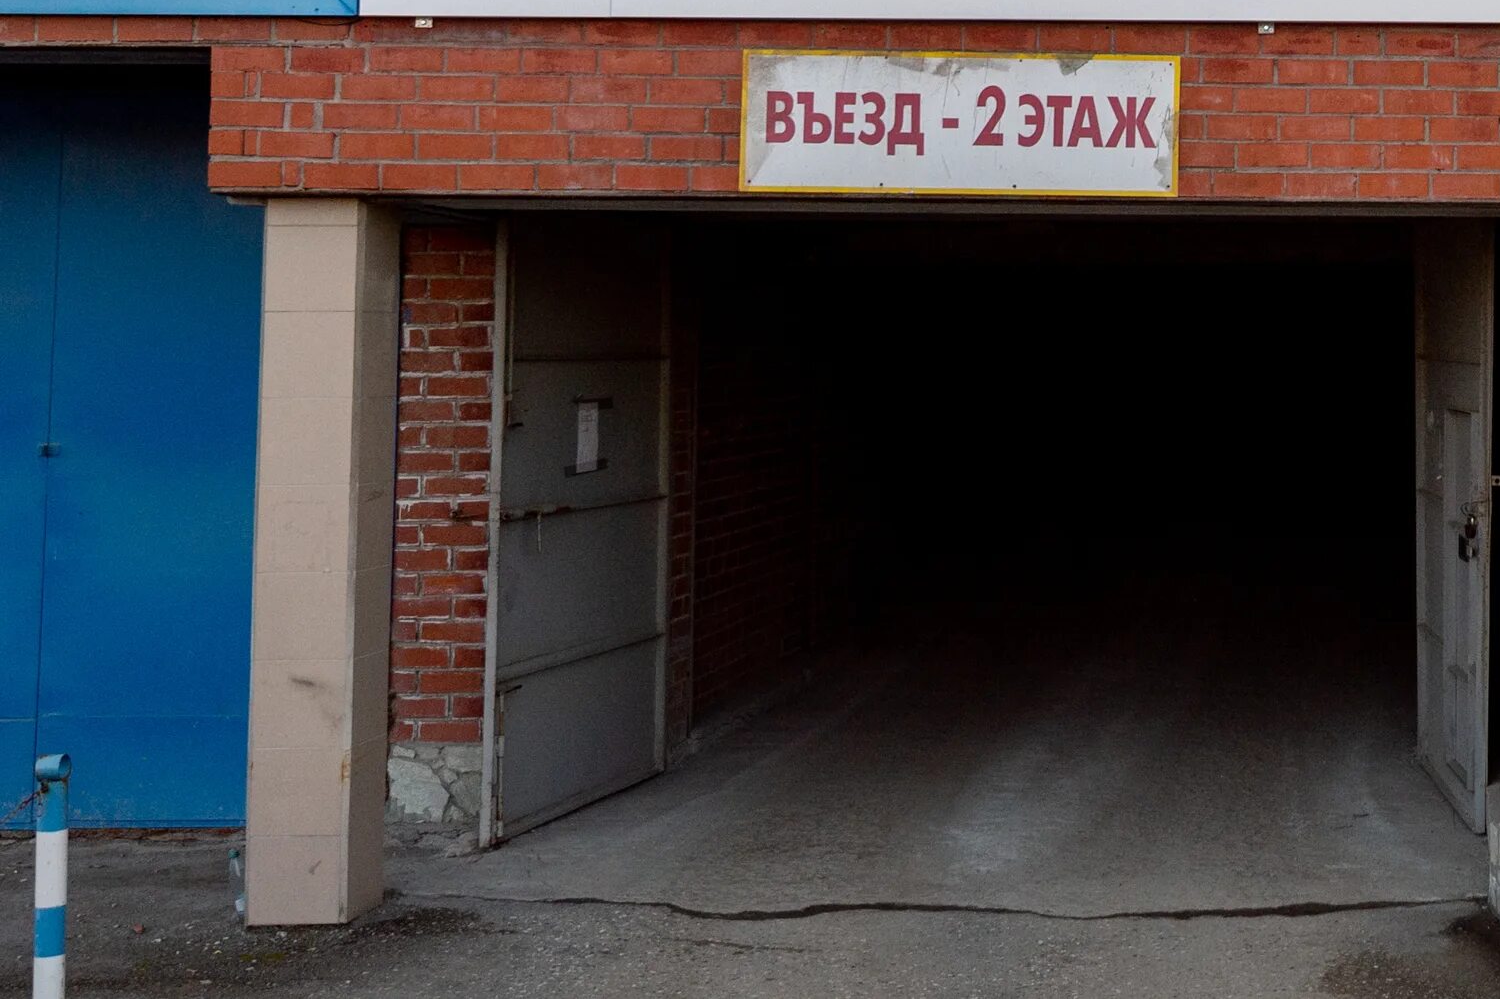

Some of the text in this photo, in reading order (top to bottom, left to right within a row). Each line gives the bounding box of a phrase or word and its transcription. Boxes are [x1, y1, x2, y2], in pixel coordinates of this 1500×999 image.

[765, 90, 925, 156] ВЪЕЗД
[972, 85, 1007, 147] 2
[1017, 93, 1157, 149] ЭТАЖ
